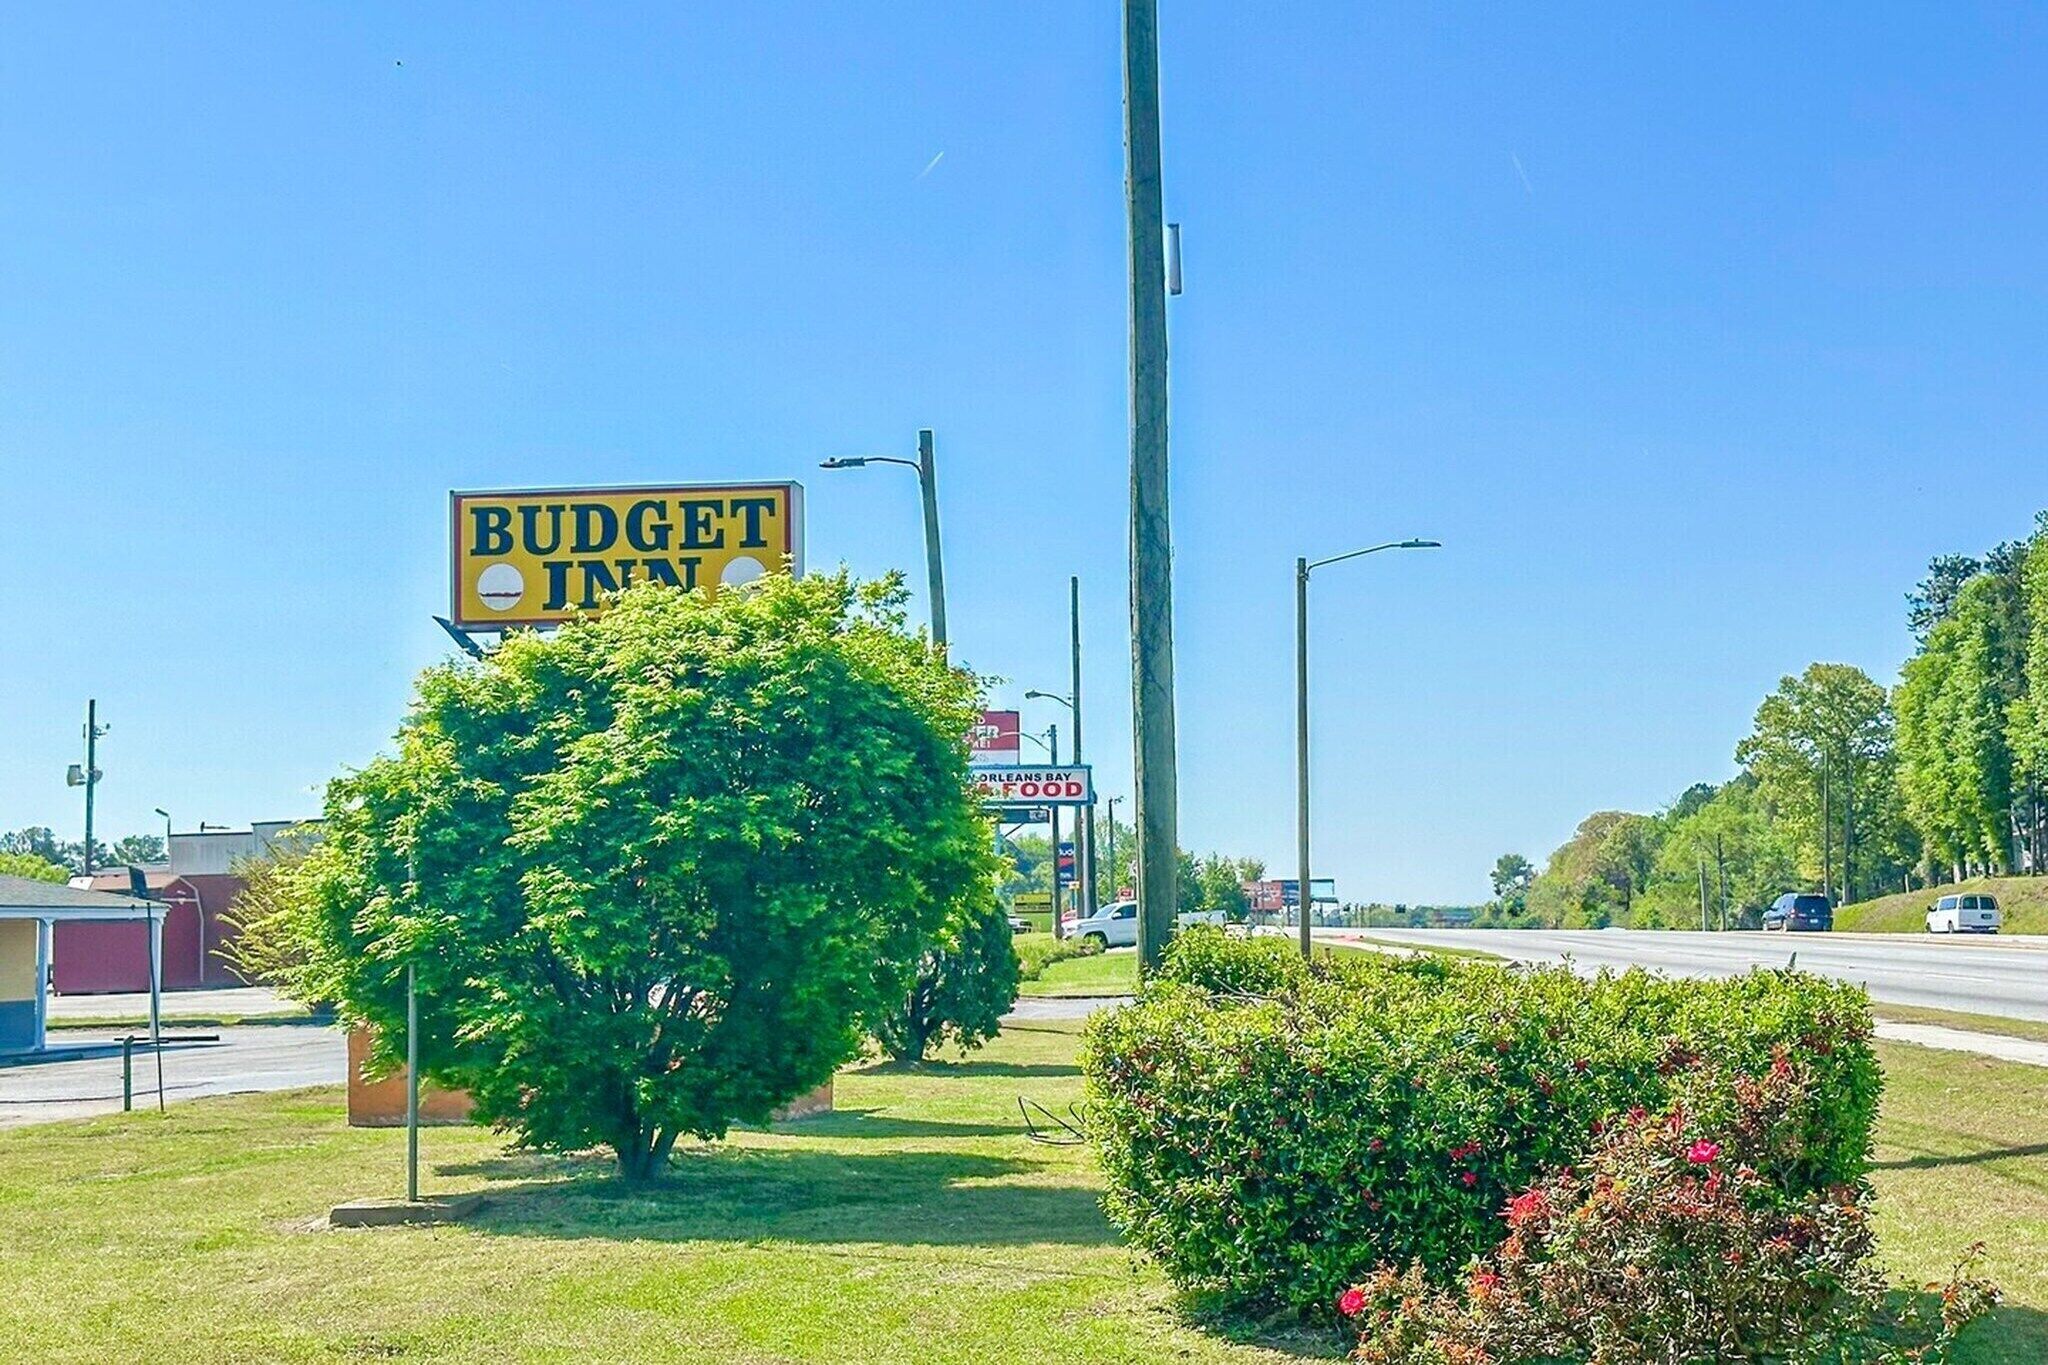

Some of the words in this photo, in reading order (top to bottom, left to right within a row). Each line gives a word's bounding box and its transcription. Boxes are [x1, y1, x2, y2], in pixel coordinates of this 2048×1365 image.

[470, 498, 776, 556] BUDGET
[542, 557, 702, 611] INN
[979, 773, 1042, 782] ORLEANS
[1046, 772, 1072, 782] BAY
[1002, 782, 1083, 797] FOOD
